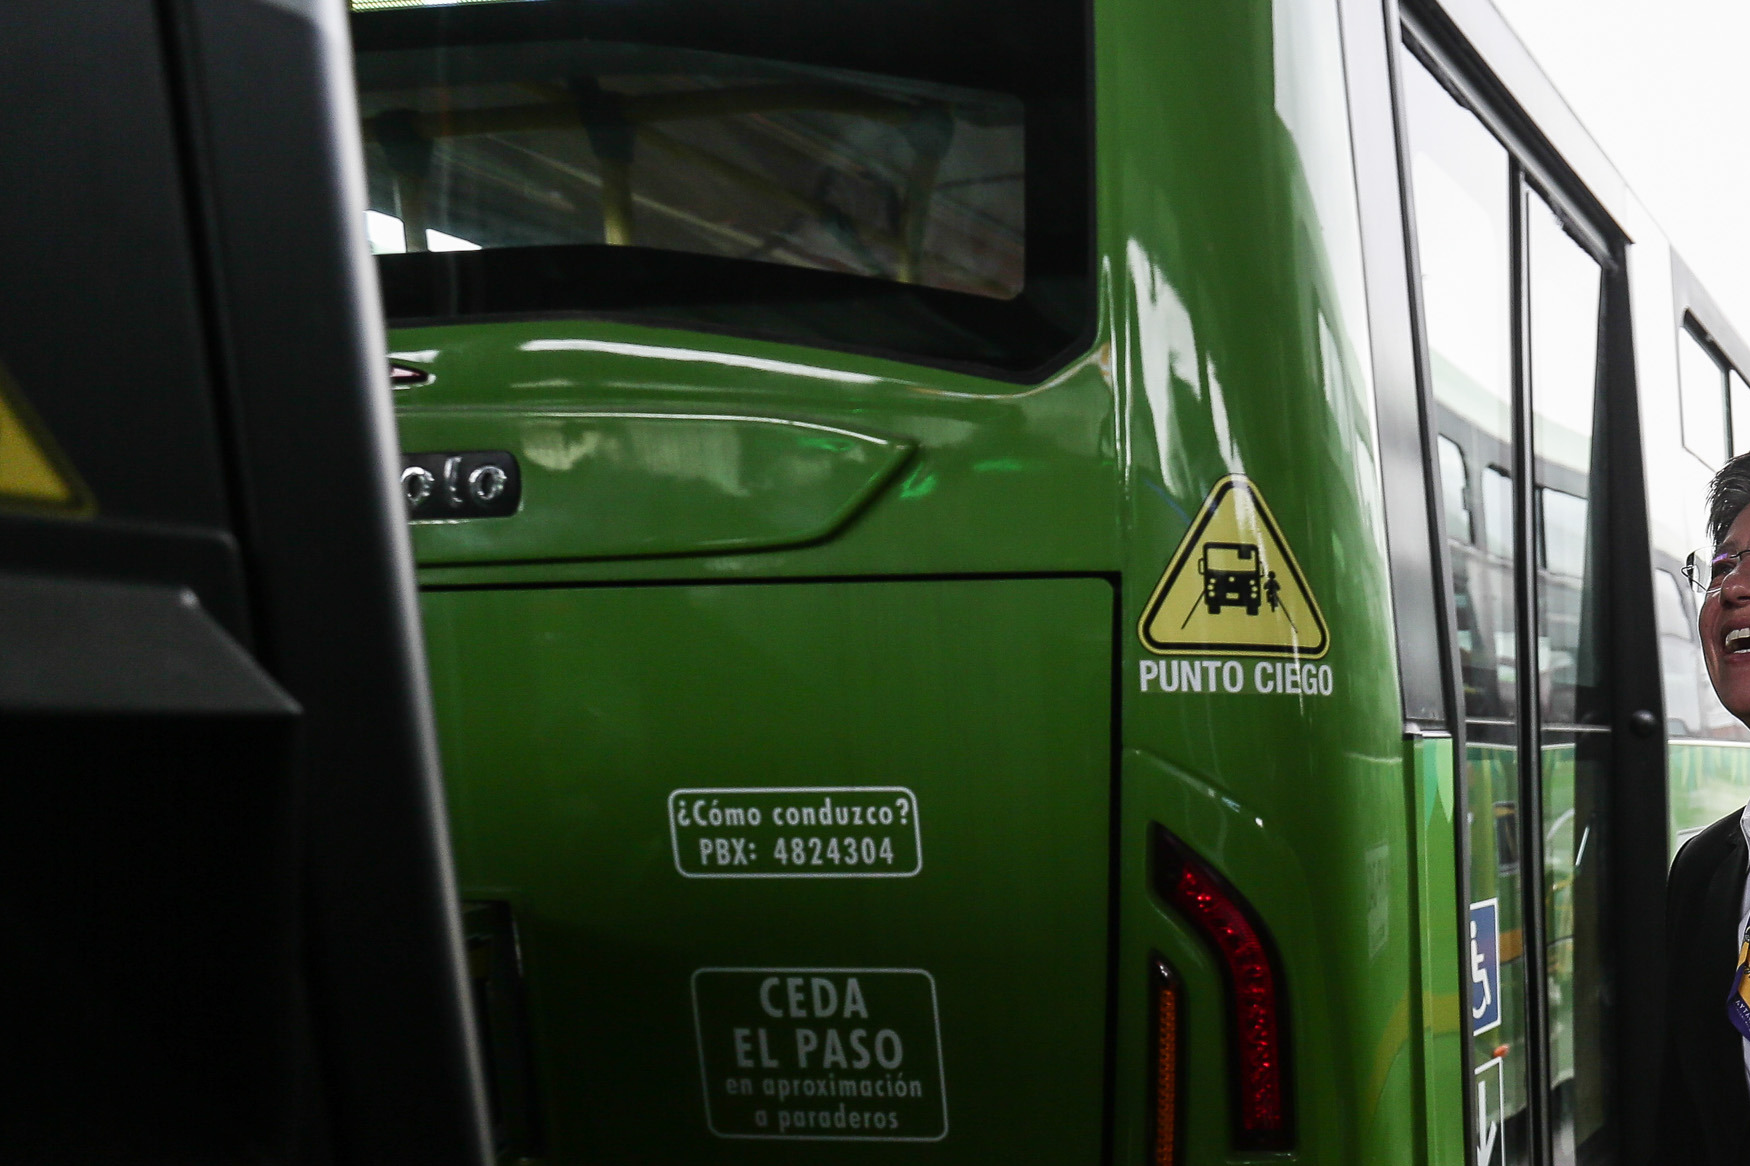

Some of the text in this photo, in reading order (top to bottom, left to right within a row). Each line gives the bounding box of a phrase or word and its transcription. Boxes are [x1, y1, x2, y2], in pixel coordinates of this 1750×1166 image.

[1138, 659, 1334, 697] PUNTO CIEGO
[676, 797, 910, 827] ¿Cómo conduzco?
[699, 836, 895, 867] PBX: 4824304
[759, 976, 870, 1020] CEDA
[732, 1026, 904, 1071] EL PASO
[725, 1072, 923, 1103] en aproximación
[754, 1102, 900, 1134] a paraderos
